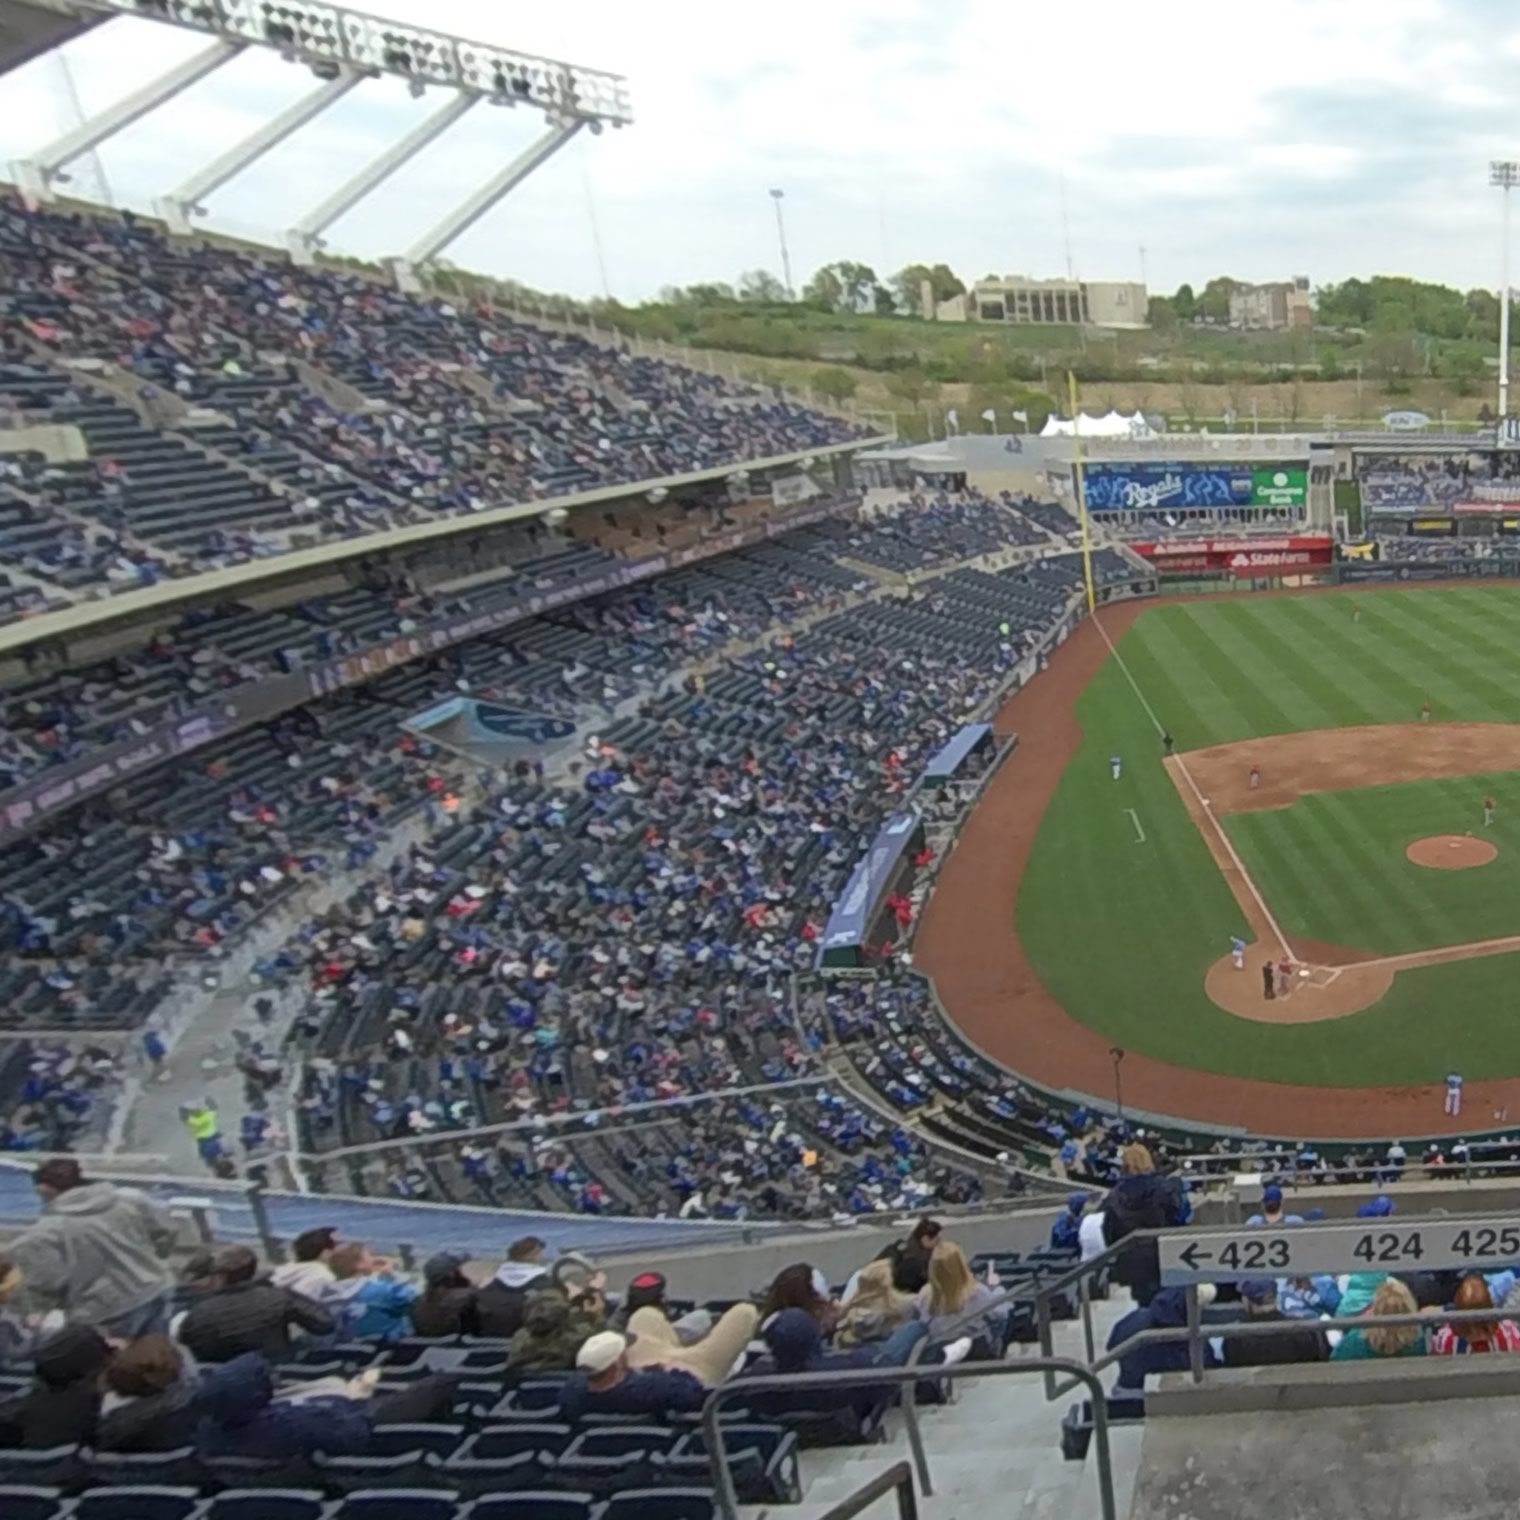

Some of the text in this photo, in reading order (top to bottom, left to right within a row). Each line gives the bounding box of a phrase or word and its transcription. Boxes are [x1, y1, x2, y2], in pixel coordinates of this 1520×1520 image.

[1126, 473, 1183, 507] Royals
[1218, 1227, 1520, 1270] 423 424 425
